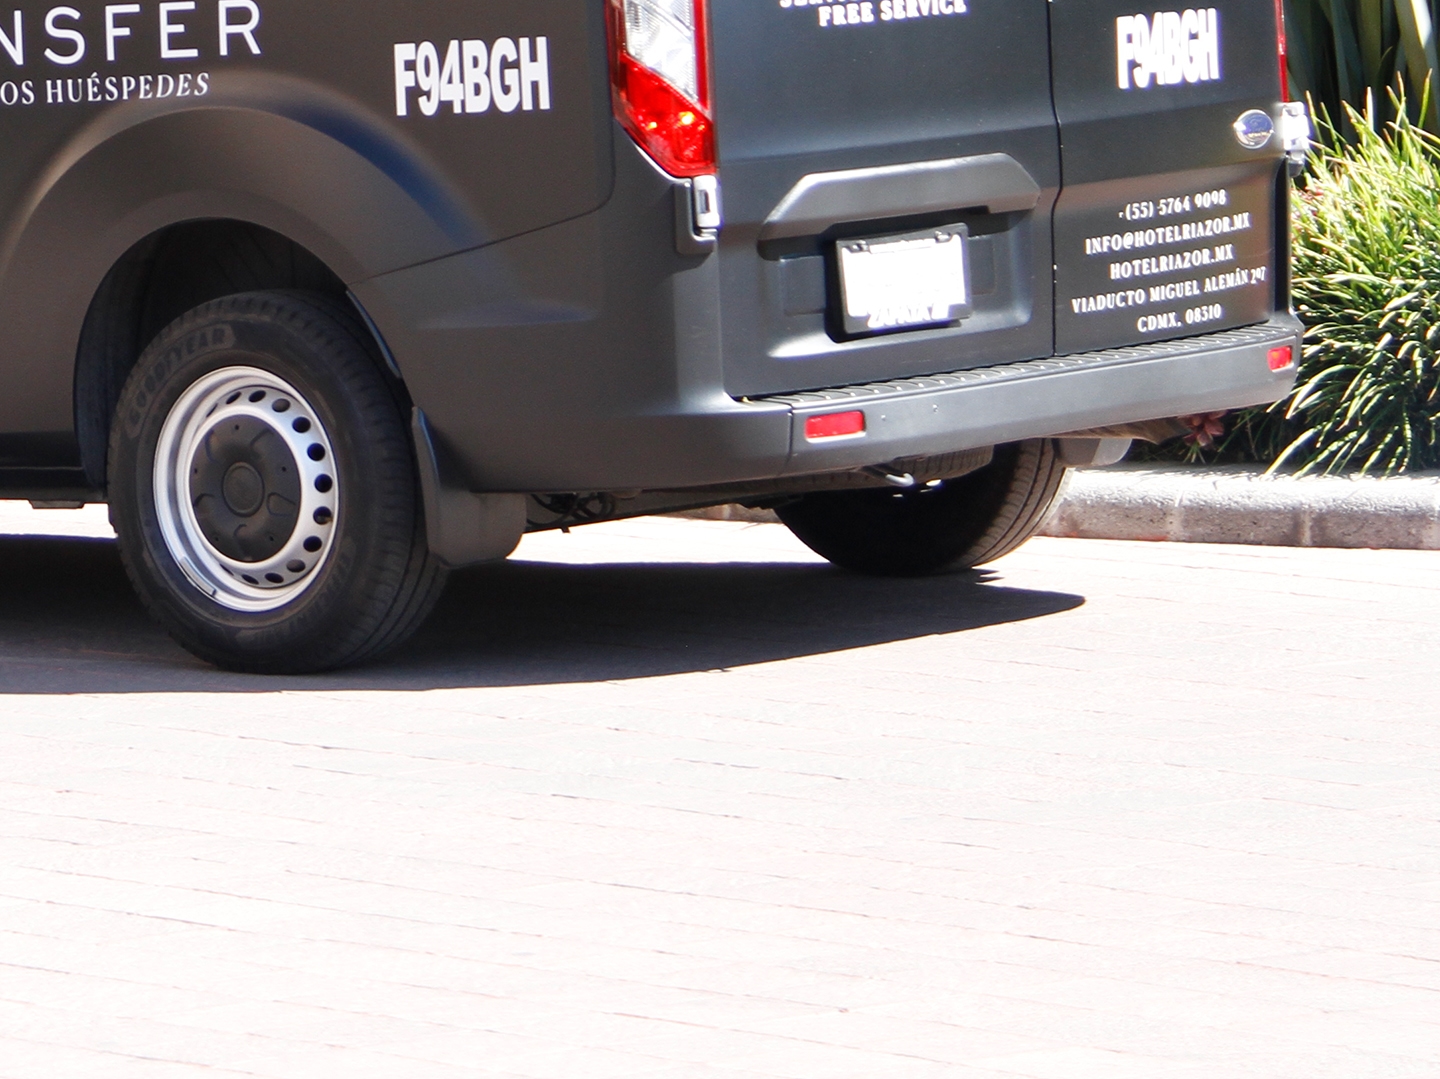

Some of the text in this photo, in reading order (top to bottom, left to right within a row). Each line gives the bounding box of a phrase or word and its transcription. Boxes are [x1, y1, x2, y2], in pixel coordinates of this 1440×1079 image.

[817, 2, 876, 27] FREE
[1116, 7, 1221, 90] F94BGH
[45, 71, 211, 104] HUÉSPEDES
[393, 36, 551, 117] F94BGH
[1157, 196, 1191, 216] 5764
[1194, 188, 1227, 208] 9098
[1085, 212, 1251, 255] INFO@HOTELRIAZOR.MX
[1109, 243, 1234, 280] HOTELRIAZOR.MX
[1071, 288, 1146, 314] VIADUCTO
[1150, 280, 1200, 302] MIGUEL
[1203, 267, 1249, 293] ALEMÁN
[1185, 303, 1223, 324] 08310
